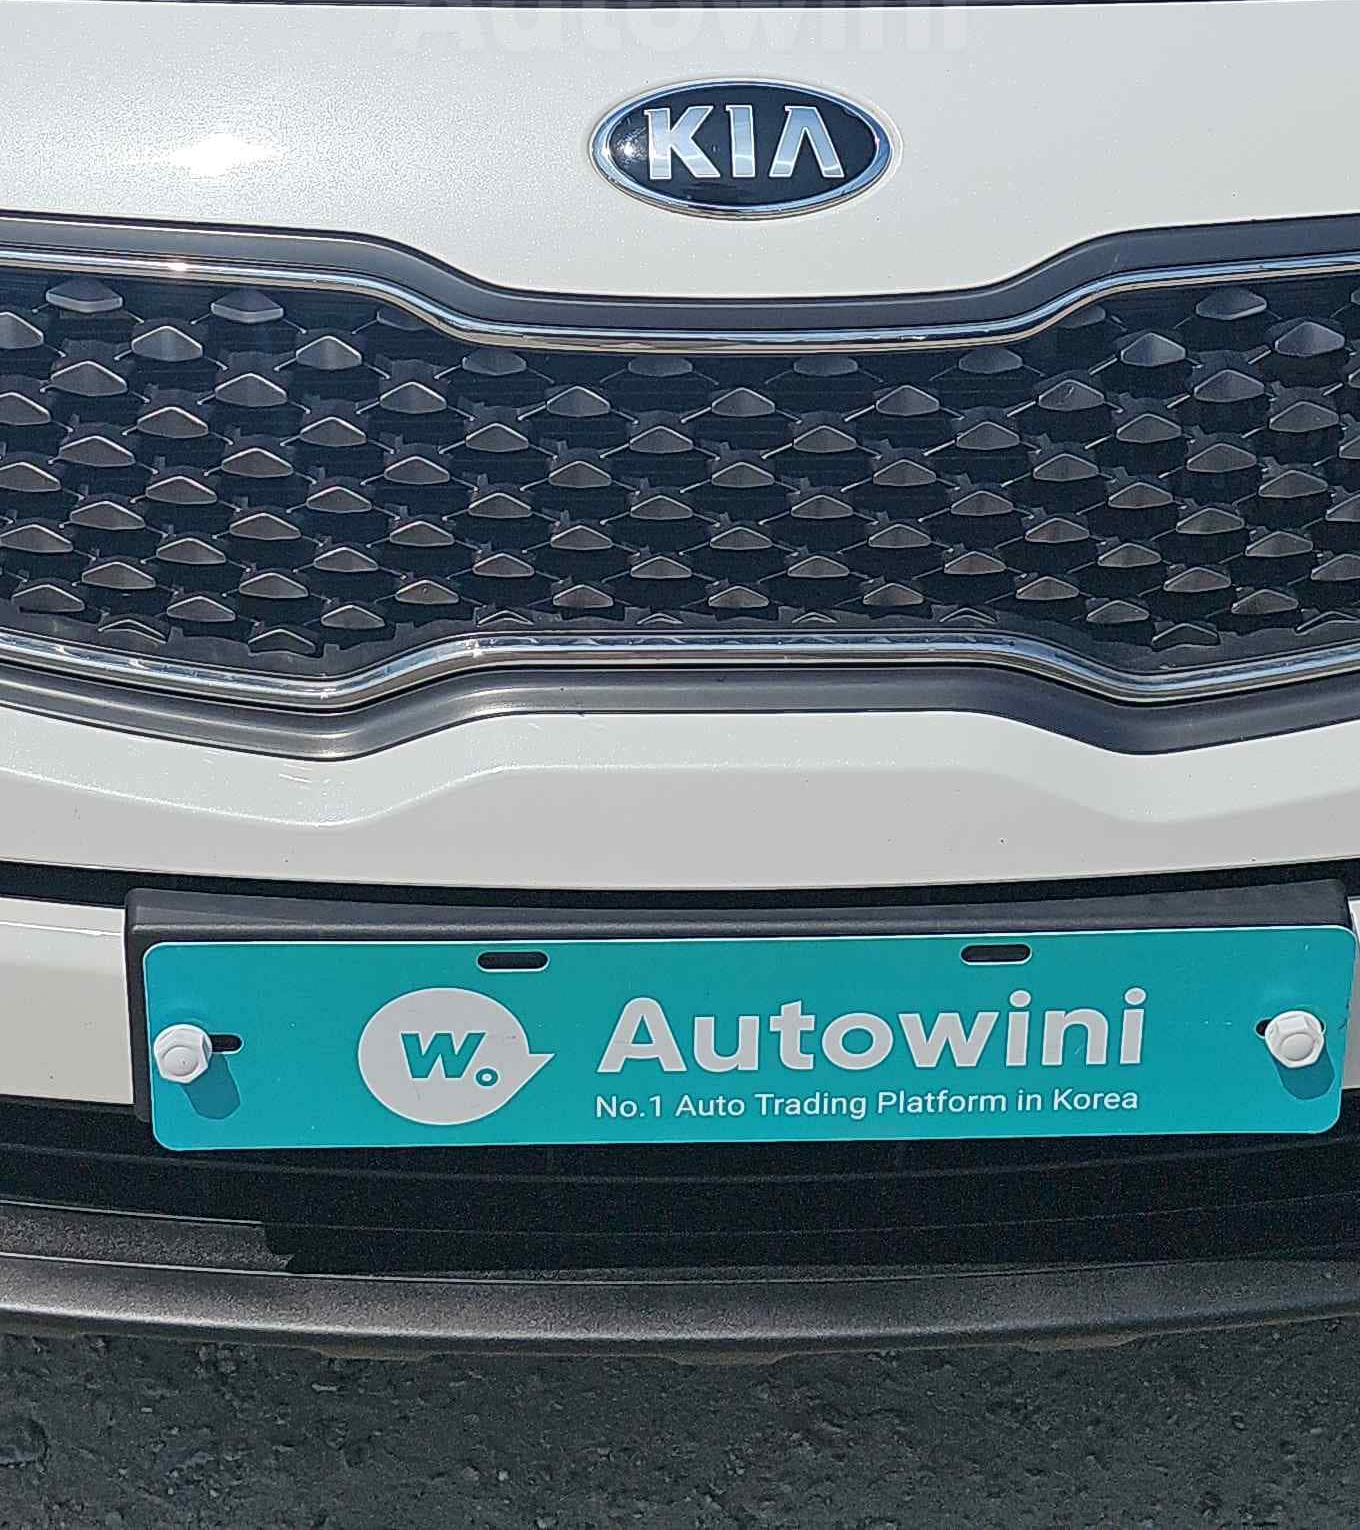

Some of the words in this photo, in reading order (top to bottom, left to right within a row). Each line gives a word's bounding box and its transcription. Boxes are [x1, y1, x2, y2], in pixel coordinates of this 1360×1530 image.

[643, 103, 845, 181] KIA
[596, 987, 1147, 1074] Autowini
[595, 1095, 662, 1119] No.1
[675, 1094, 745, 1117] Auto
[755, 1091, 867, 1120] Trading
[878, 1089, 1007, 1114] Platform
[1016, 1089, 1042, 1111] in
[1053, 1088, 1139, 1111] Korea
